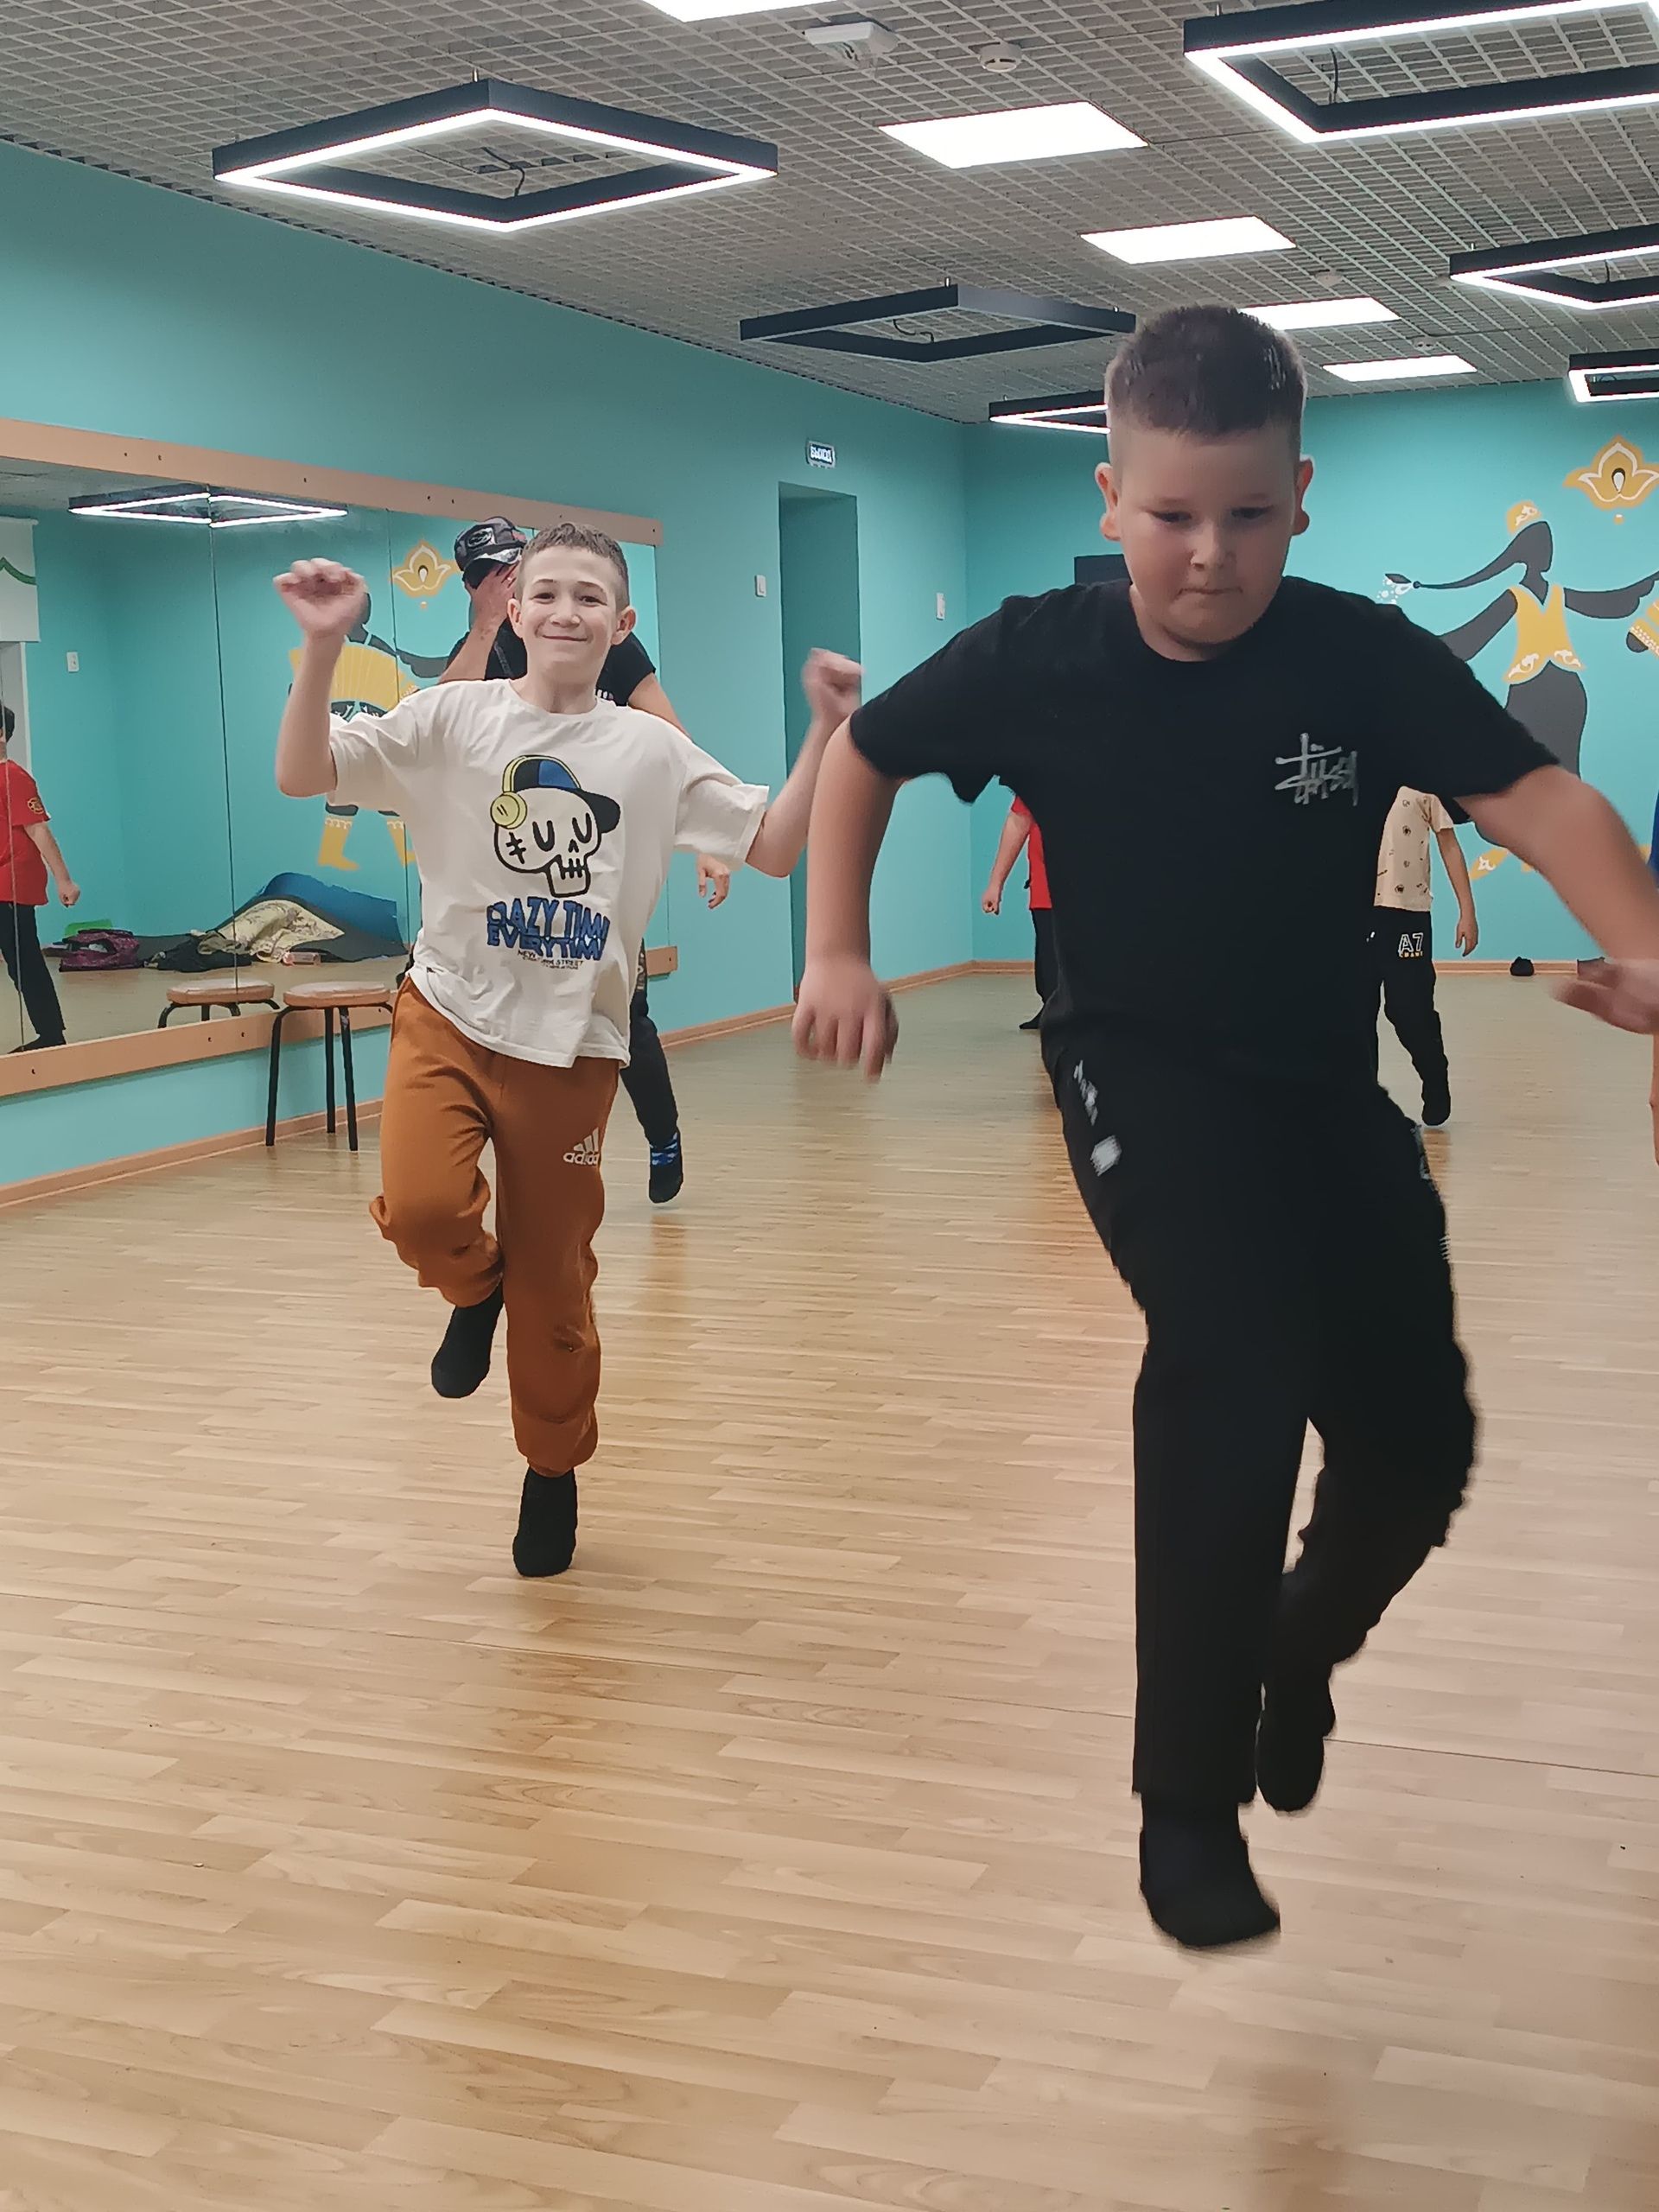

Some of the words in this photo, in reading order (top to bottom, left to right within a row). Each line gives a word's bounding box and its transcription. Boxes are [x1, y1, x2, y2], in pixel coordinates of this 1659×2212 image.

[563, 900, 610, 939] TIM
[486, 923, 609, 961] EVERYTIM
[1398, 932, 1424, 953] A7
[563, 1152, 600, 1166] adida
